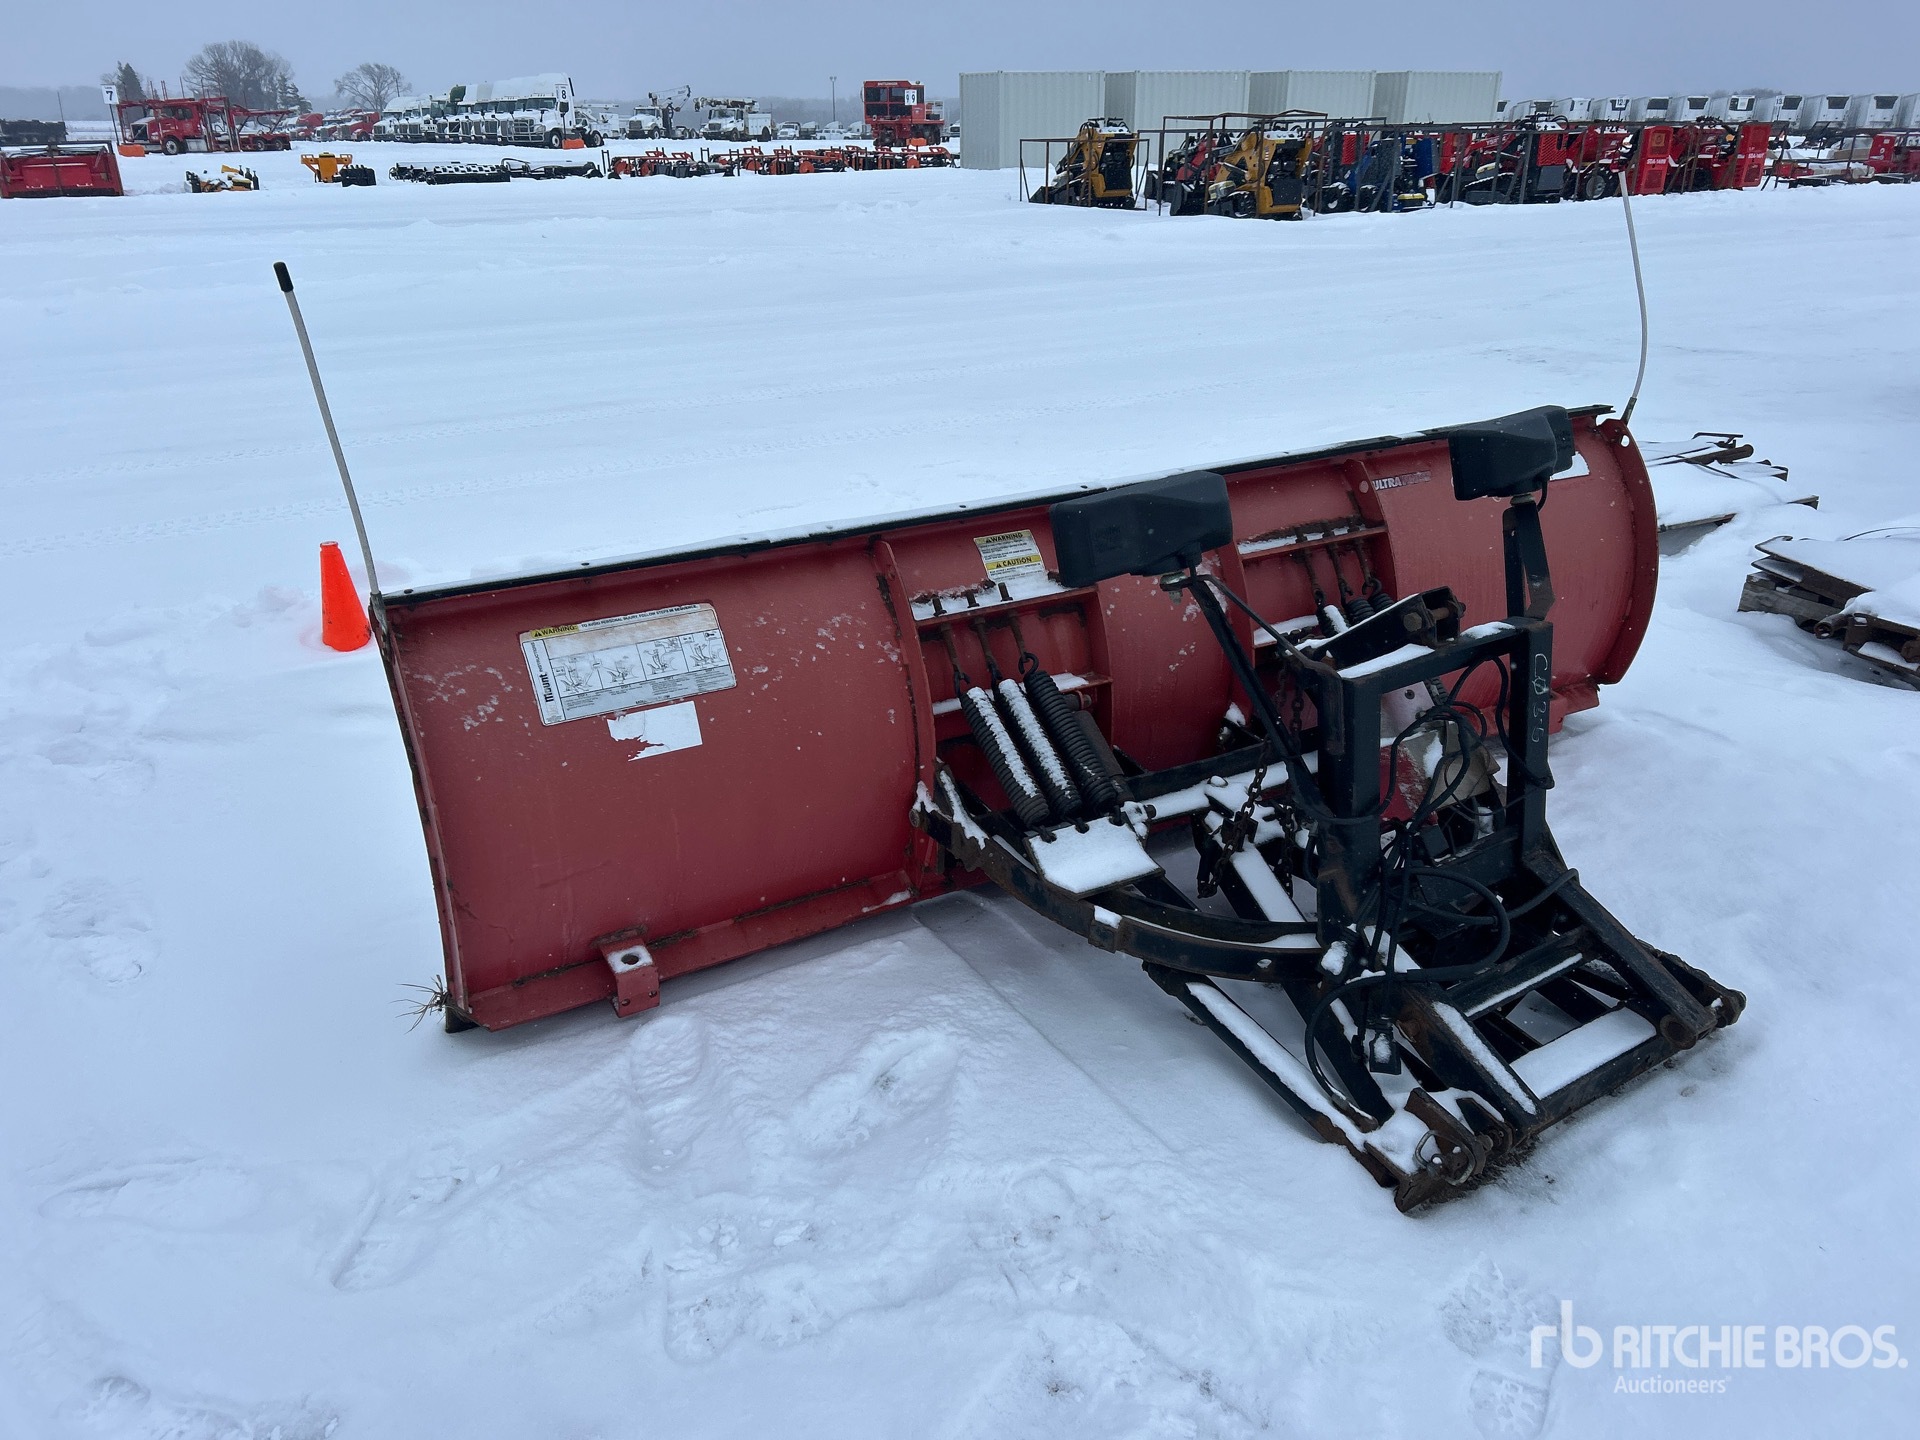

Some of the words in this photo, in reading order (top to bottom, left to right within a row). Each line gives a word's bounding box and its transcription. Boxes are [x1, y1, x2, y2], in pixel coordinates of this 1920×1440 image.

[105, 90, 113, 101] 7
[561, 89, 567, 100] 8
[911, 93, 916, 103] 9
[1372, 476, 1402, 490] ULTRA
[990, 532, 1023, 542] WARNING
[1002, 556, 1032, 567] CAUTION
[531, 642, 543, 672] INSTRUCTIONS
